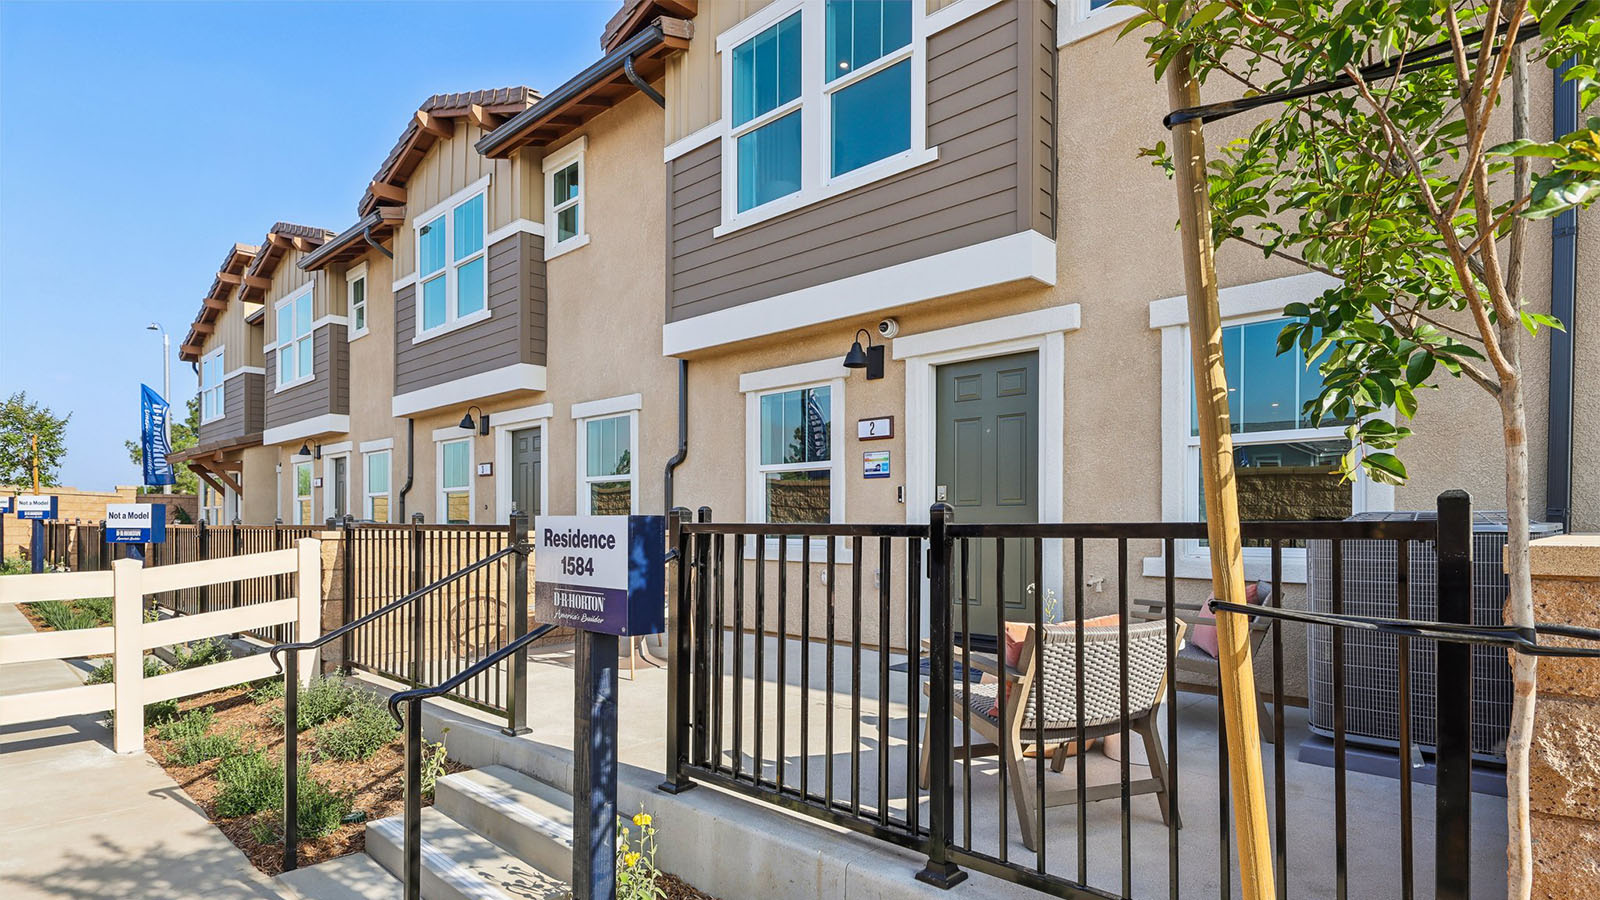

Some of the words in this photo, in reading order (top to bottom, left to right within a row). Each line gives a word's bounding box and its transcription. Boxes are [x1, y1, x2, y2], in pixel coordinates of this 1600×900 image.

[869, 421, 875, 436] 2
[544, 528, 616, 550] Residence
[561, 556, 594, 576] 1584
[554, 610, 580, 620] America's
[580, 612, 604, 624] Builder
